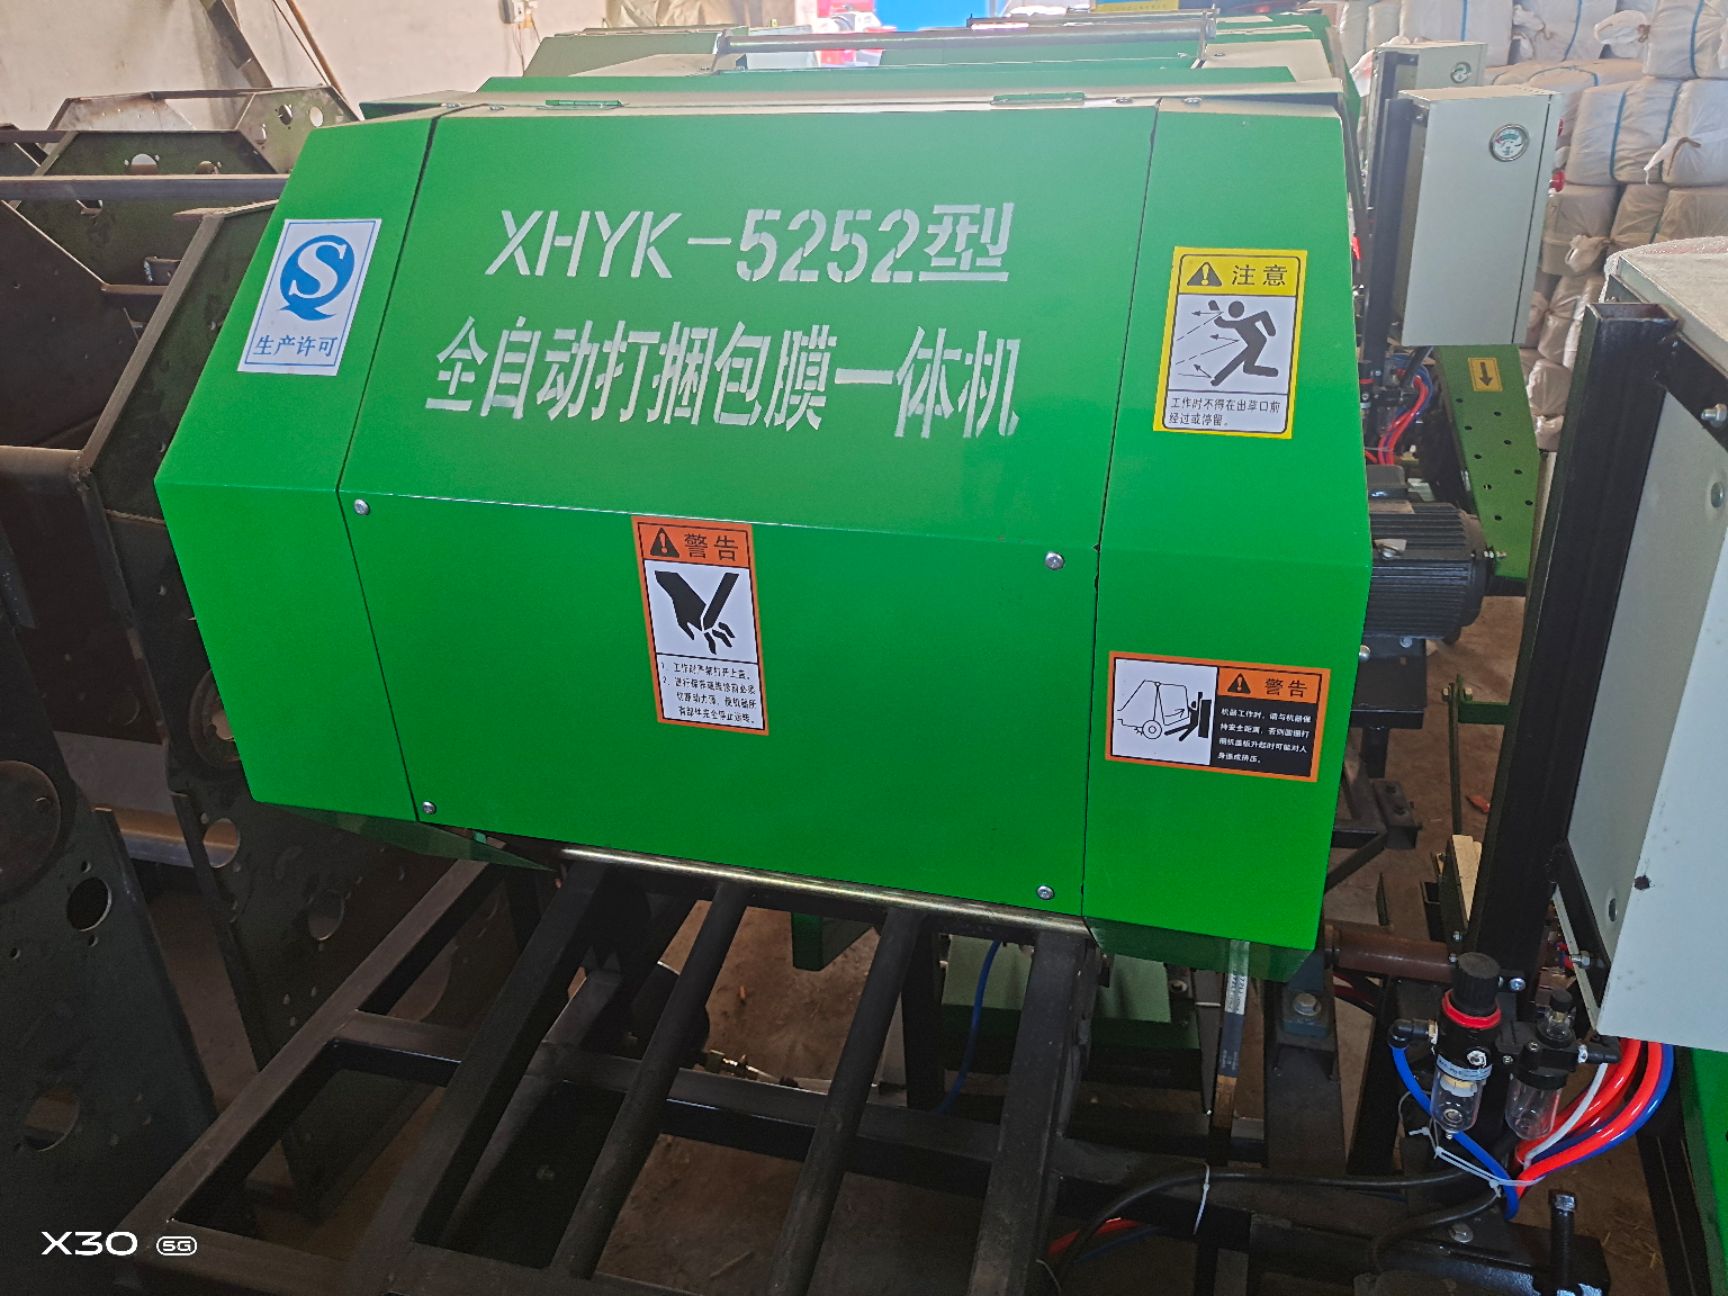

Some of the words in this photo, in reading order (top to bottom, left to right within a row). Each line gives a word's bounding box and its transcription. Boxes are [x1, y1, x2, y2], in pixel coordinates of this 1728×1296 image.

[1232, 264, 1287, 286] 注意
[253, 335, 337, 357] 生产许可
[425, 316, 1021, 438] 全自动打捆包膜一体机
[684, 533, 738, 561] 警告
[1265, 678, 1307, 697] 警告
